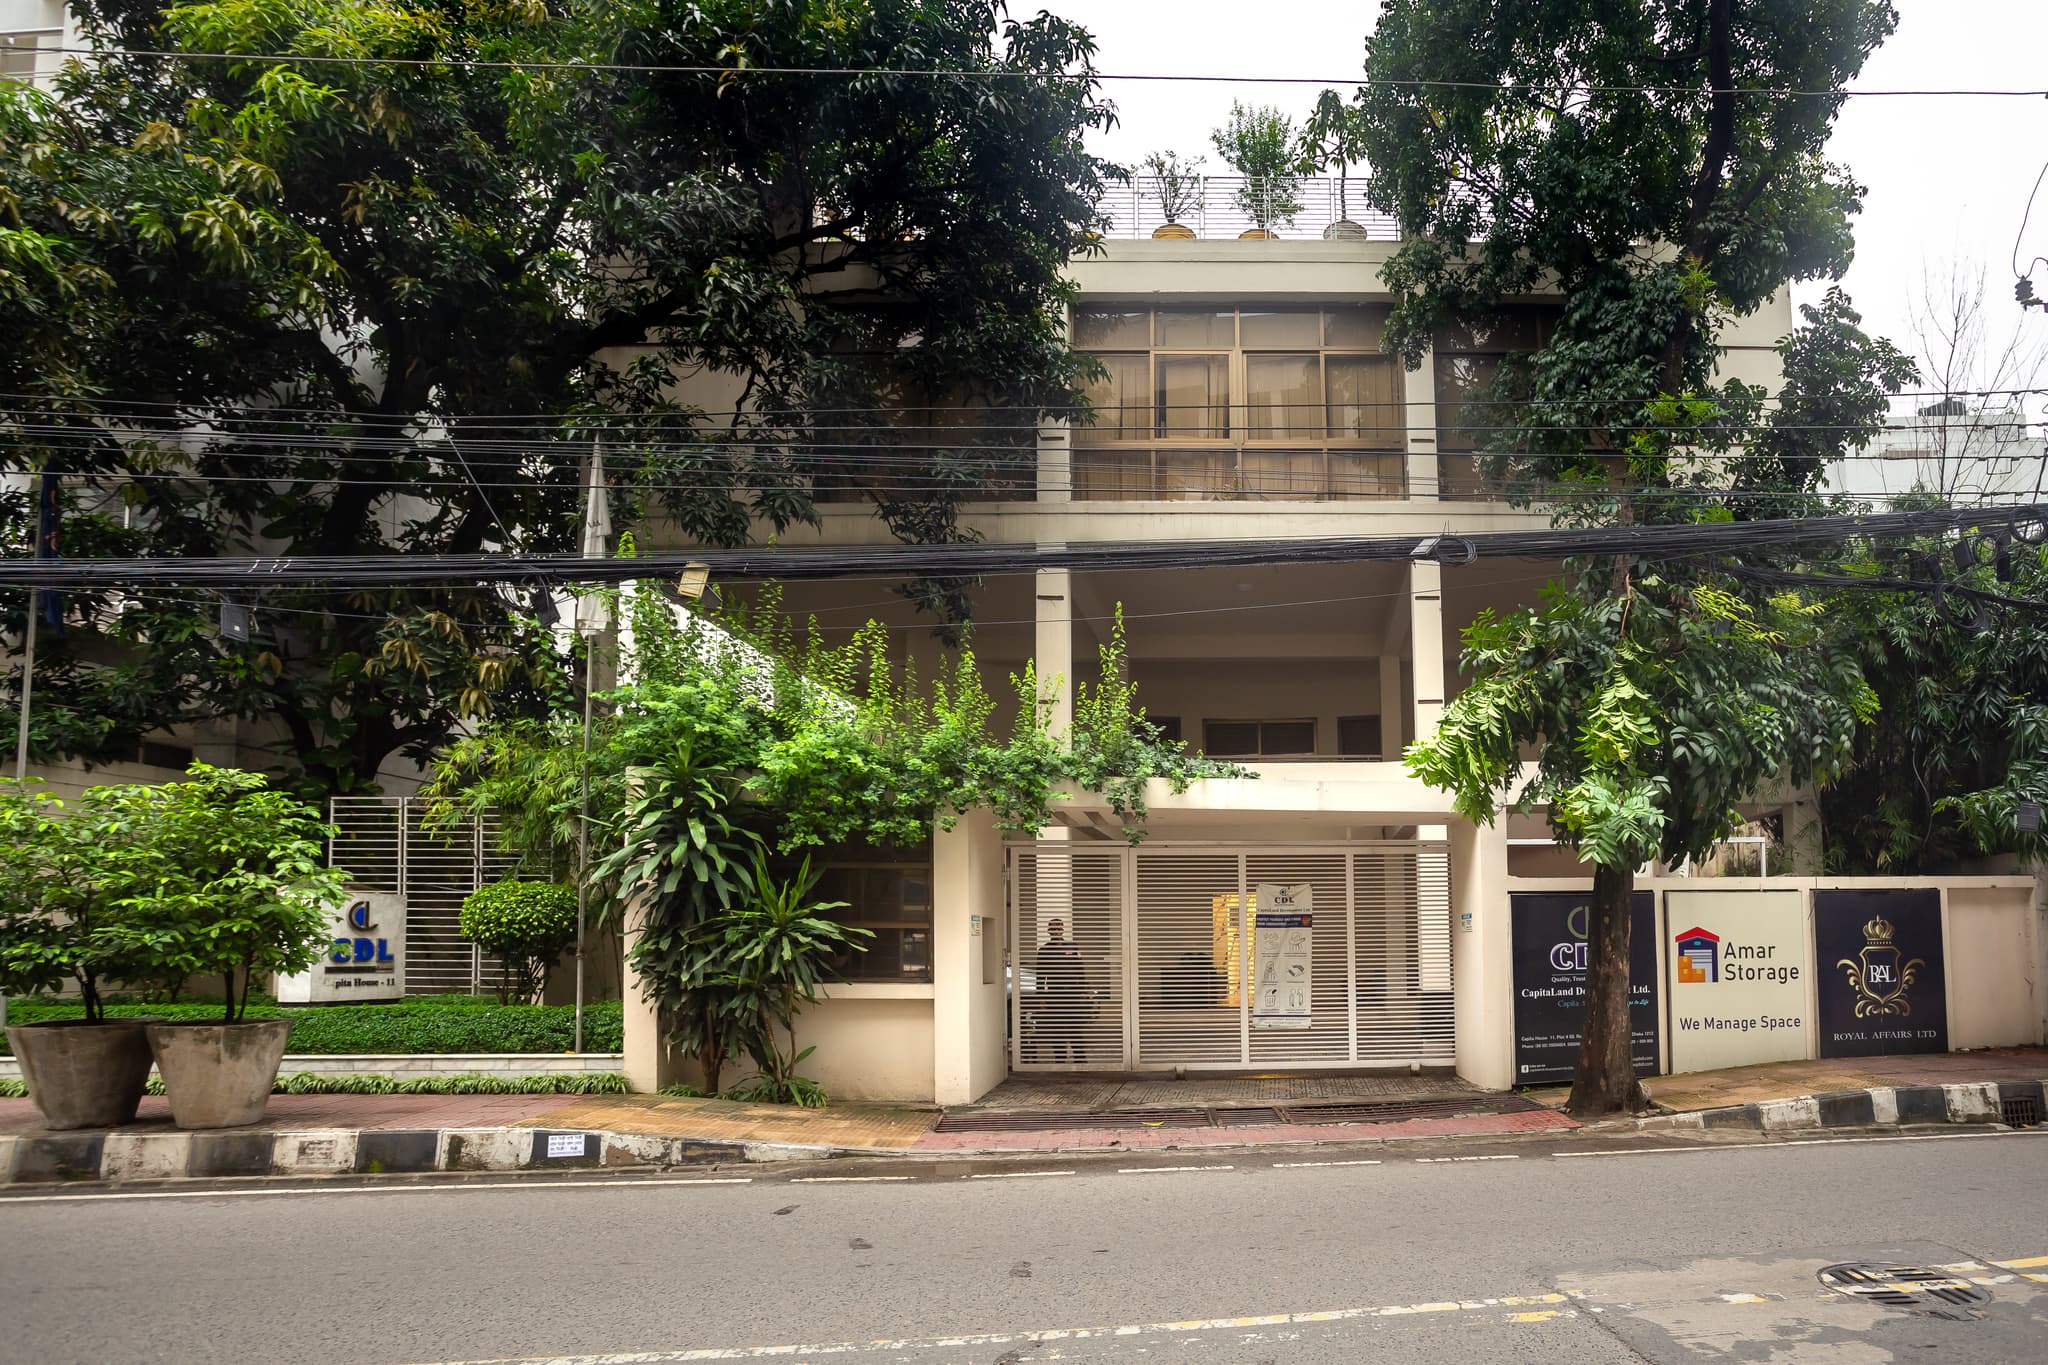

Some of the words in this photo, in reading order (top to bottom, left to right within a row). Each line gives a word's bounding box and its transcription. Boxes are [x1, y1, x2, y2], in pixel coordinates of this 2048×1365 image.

[1274, 896, 1295, 904] CDL
[1724, 942, 1776, 960] Amar
[1724, 963, 1800, 984] Storage
[354, 978, 379, 987] House
[387, 978, 395, 986] 11
[1521, 987, 1574, 999] CapitaLand
[1633, 985, 1651, 994] Ltd.
[1680, 1017, 1700, 1031] We
[1704, 1017, 1757, 1032] Manage
[1760, 1015, 1801, 1031] Space
[1833, 1032, 1867, 1041] ROYAL
[1872, 1030, 1912, 1040] AFFAIRS
[1917, 1029, 1937, 1039] LTD
